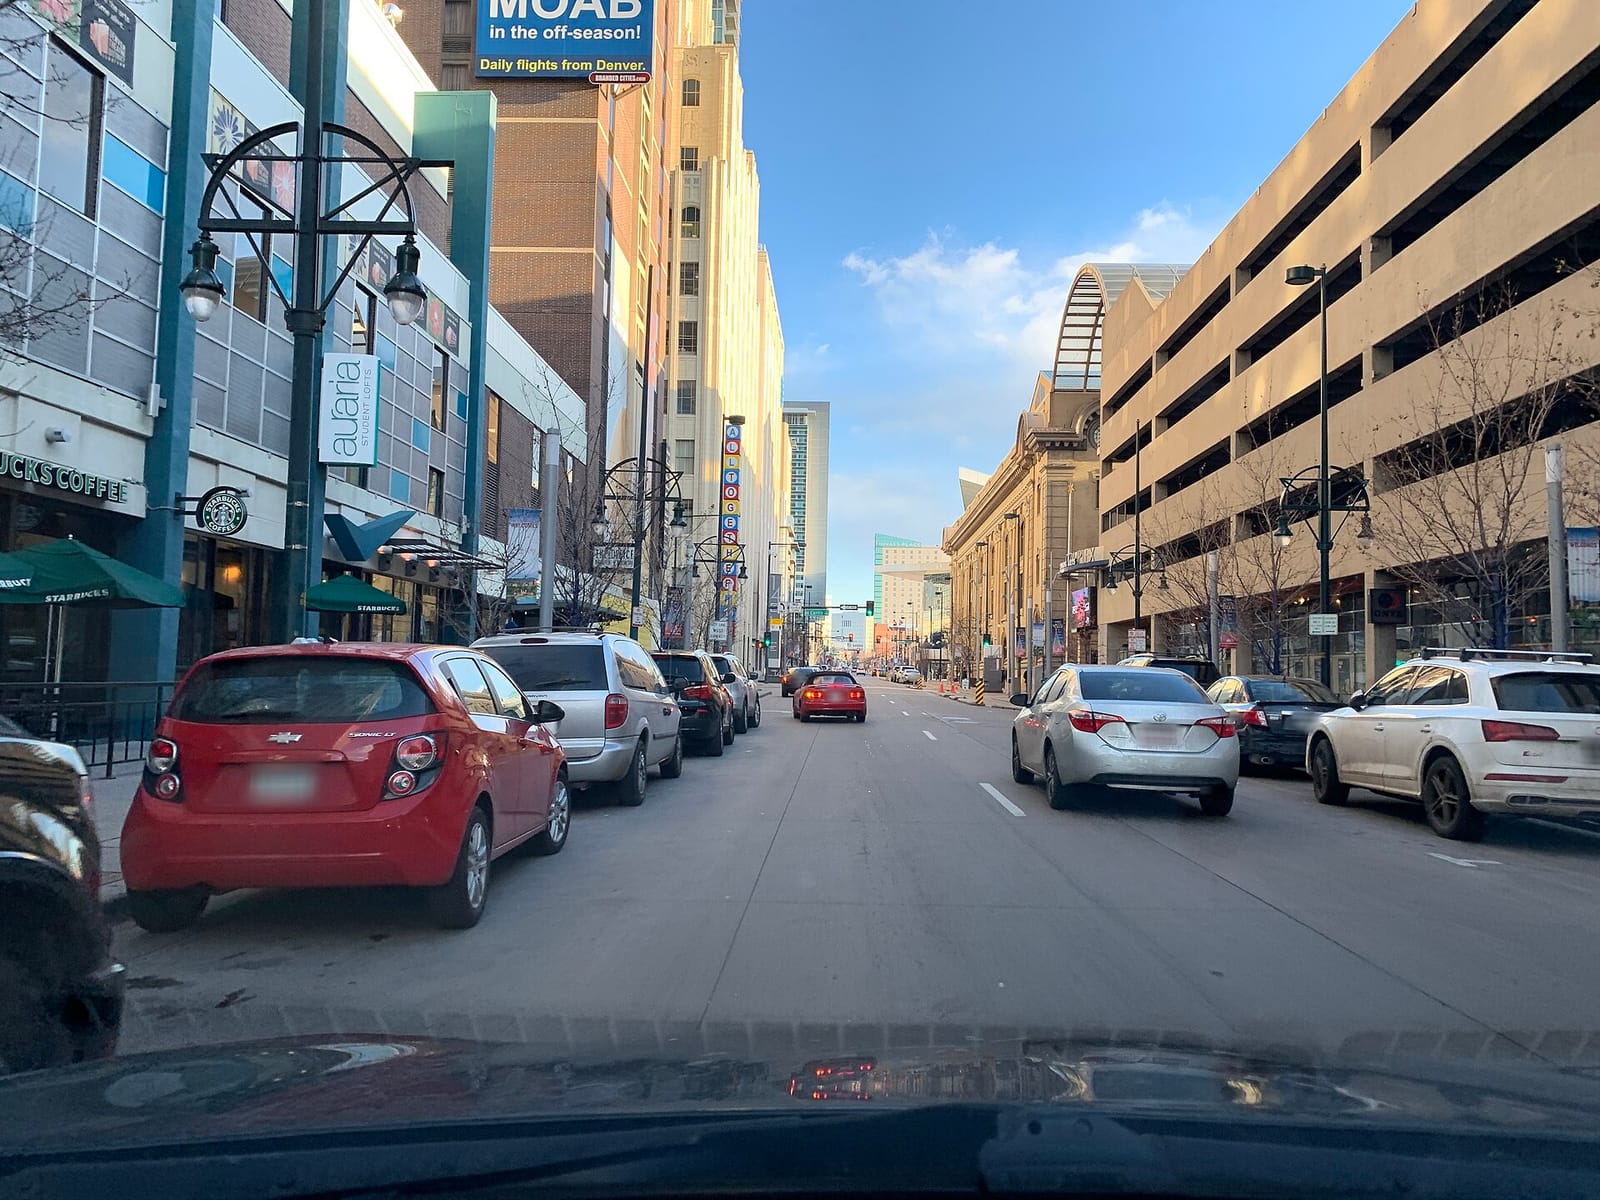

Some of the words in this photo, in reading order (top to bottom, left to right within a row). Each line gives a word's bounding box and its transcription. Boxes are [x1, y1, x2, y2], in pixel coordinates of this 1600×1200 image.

[489, 25, 505, 39] in
[510, 25, 538, 39] the
[542, 25, 641, 40] off-season!
[480, 59, 513, 73] Daily
[516, 59, 558, 73] flights
[561, 59, 592, 71] from
[596, 60, 646, 71] Denver.
[363, 368, 372, 400] LOFTS
[328, 360, 361, 457] auraria
[361, 403, 370, 447] STUDENT
[56, 466, 129, 504] COFFEE
[205, 495, 241, 513] STARBUCKS
[208, 521, 236, 533] COFFEE
[45, 588, 109, 603] STARBUCKS
